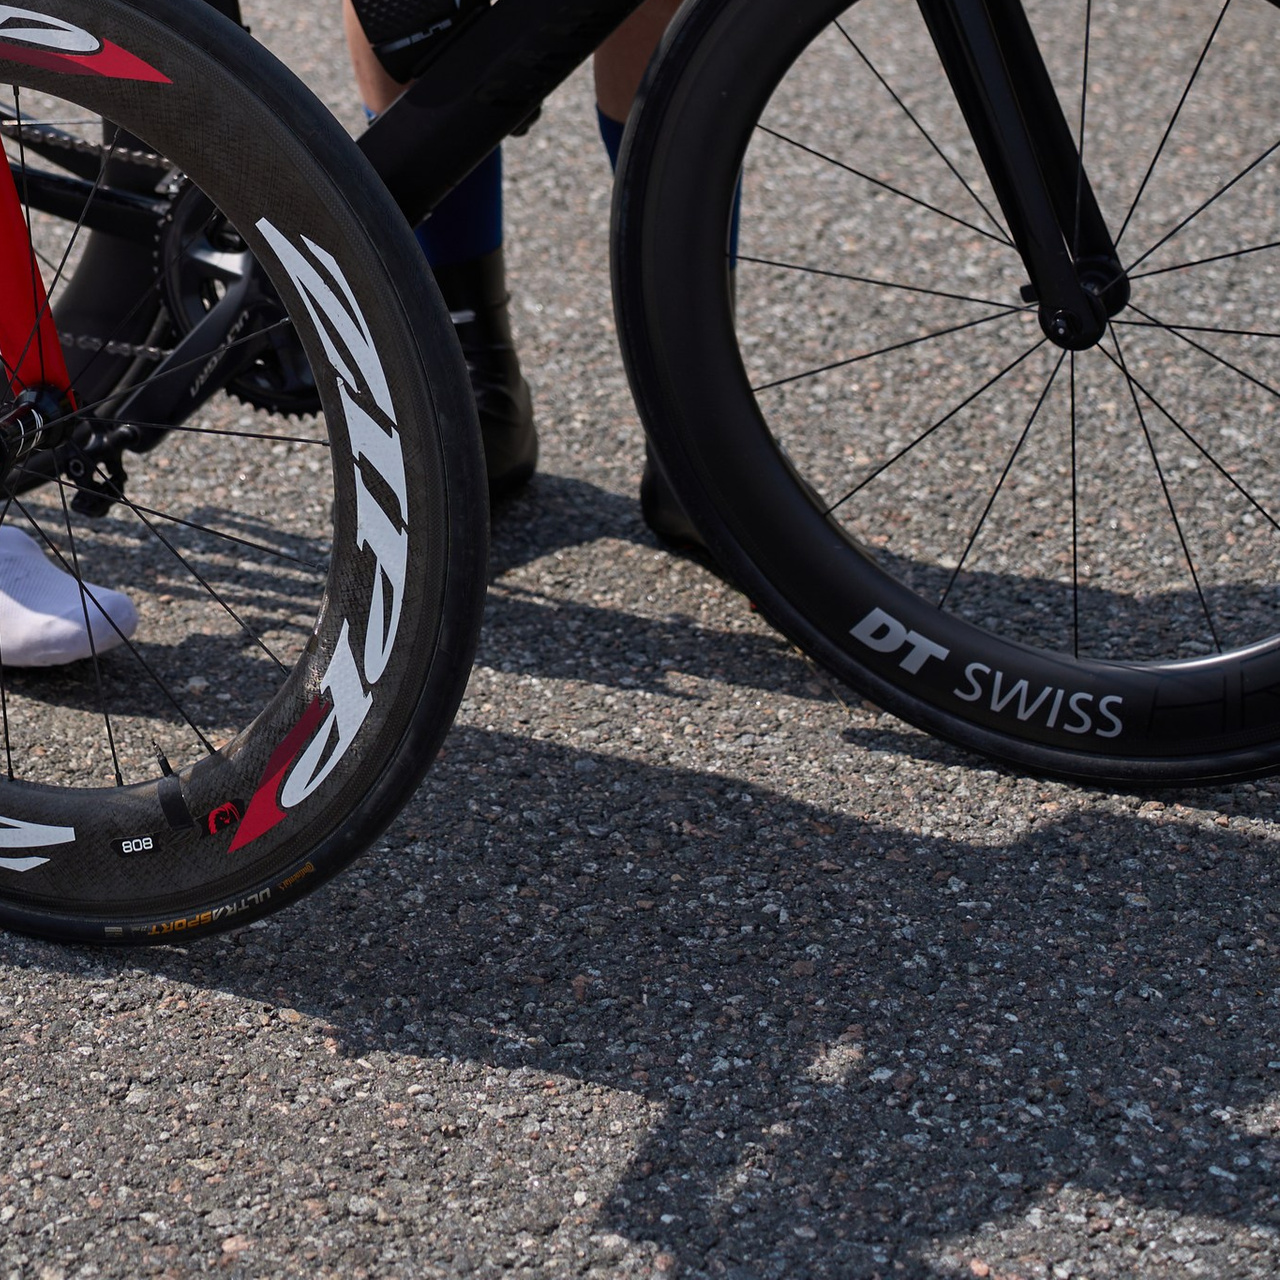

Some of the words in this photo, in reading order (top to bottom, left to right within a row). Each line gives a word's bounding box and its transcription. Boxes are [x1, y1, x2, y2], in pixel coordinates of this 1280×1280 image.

[255, 217, 408, 808] ZIPP
[848, 607, 950, 676] DT
[953, 662, 1124, 738] SWISS
[122, 837, 154, 854] 808
